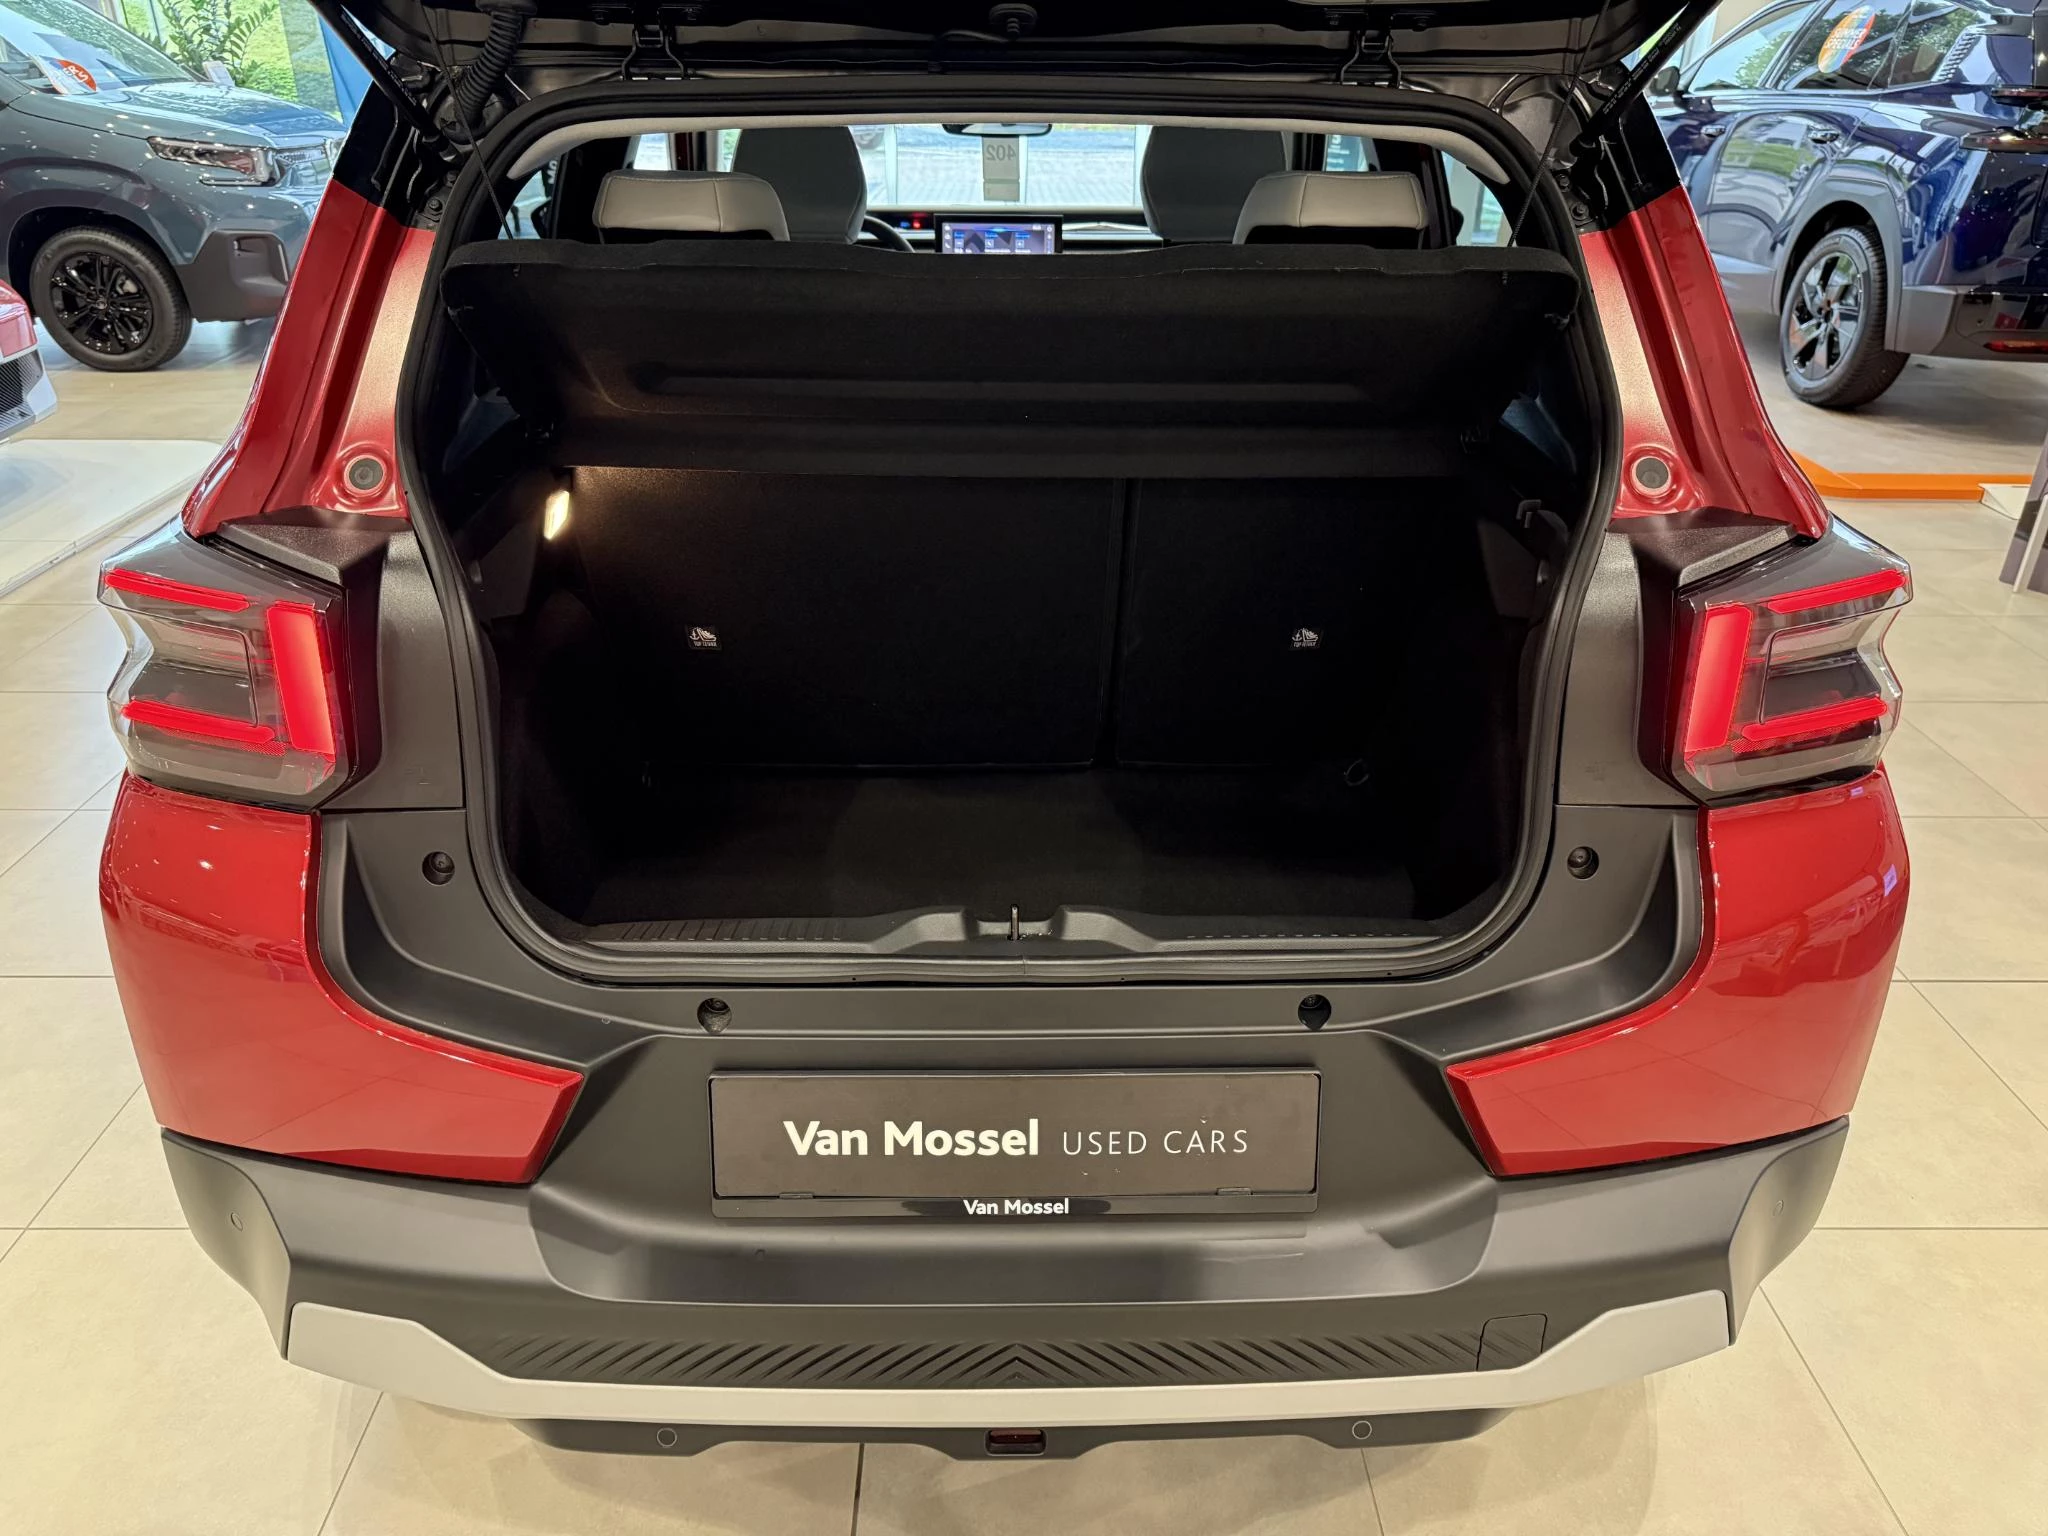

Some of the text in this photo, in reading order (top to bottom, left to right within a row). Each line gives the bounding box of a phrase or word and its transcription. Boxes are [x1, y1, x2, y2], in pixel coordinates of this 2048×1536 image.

[783, 1118, 1248, 1157] Van Mossel USED CARS
[963, 1197, 1069, 1215] Van Mossel
